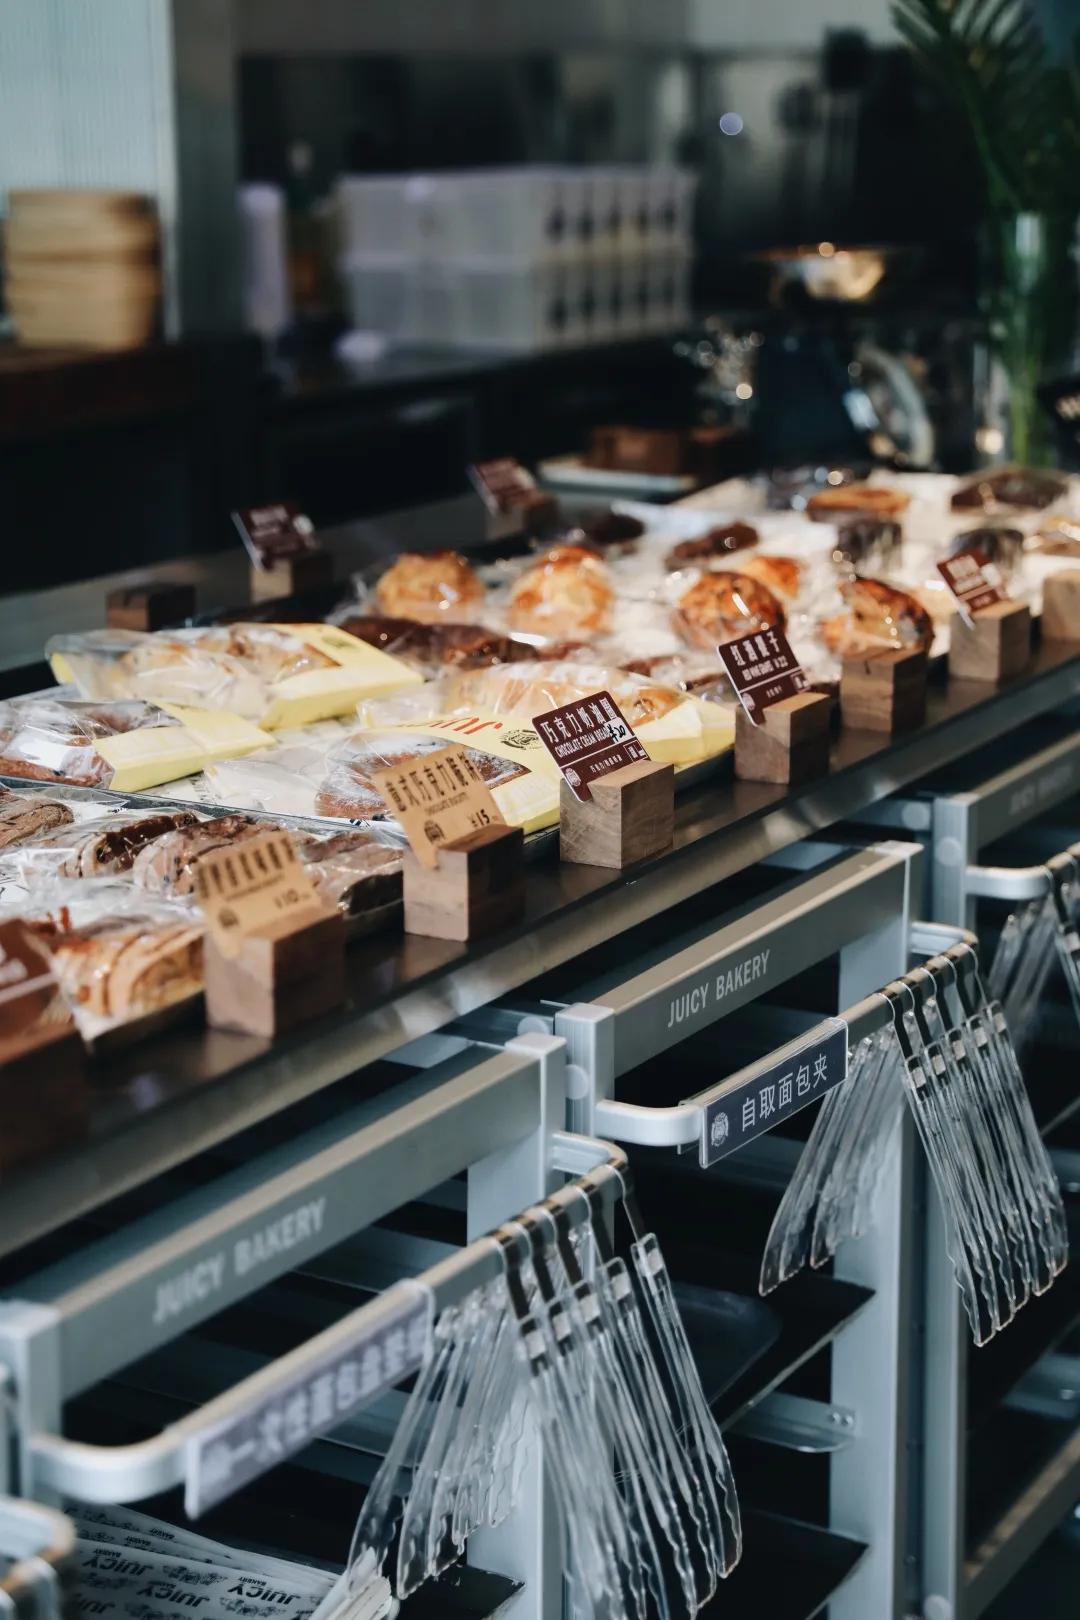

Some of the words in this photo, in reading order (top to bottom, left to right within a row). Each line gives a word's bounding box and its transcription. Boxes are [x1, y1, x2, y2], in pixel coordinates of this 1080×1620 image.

[554, 735, 583, 758] CHOCOLATE
[667, 983, 710, 1027] JUICY
[716, 949, 770, 999] BAKERY
[741, 1053, 828, 1132] 自取面包夹
[153, 1255, 224, 1324] JUICY
[234, 1199, 325, 1276] BAKERY
[82, 1556, 153, 1576] JUICY
[136, 1585, 210, 1608] JUICY
[228, 1583, 301, 1605] JUICY
